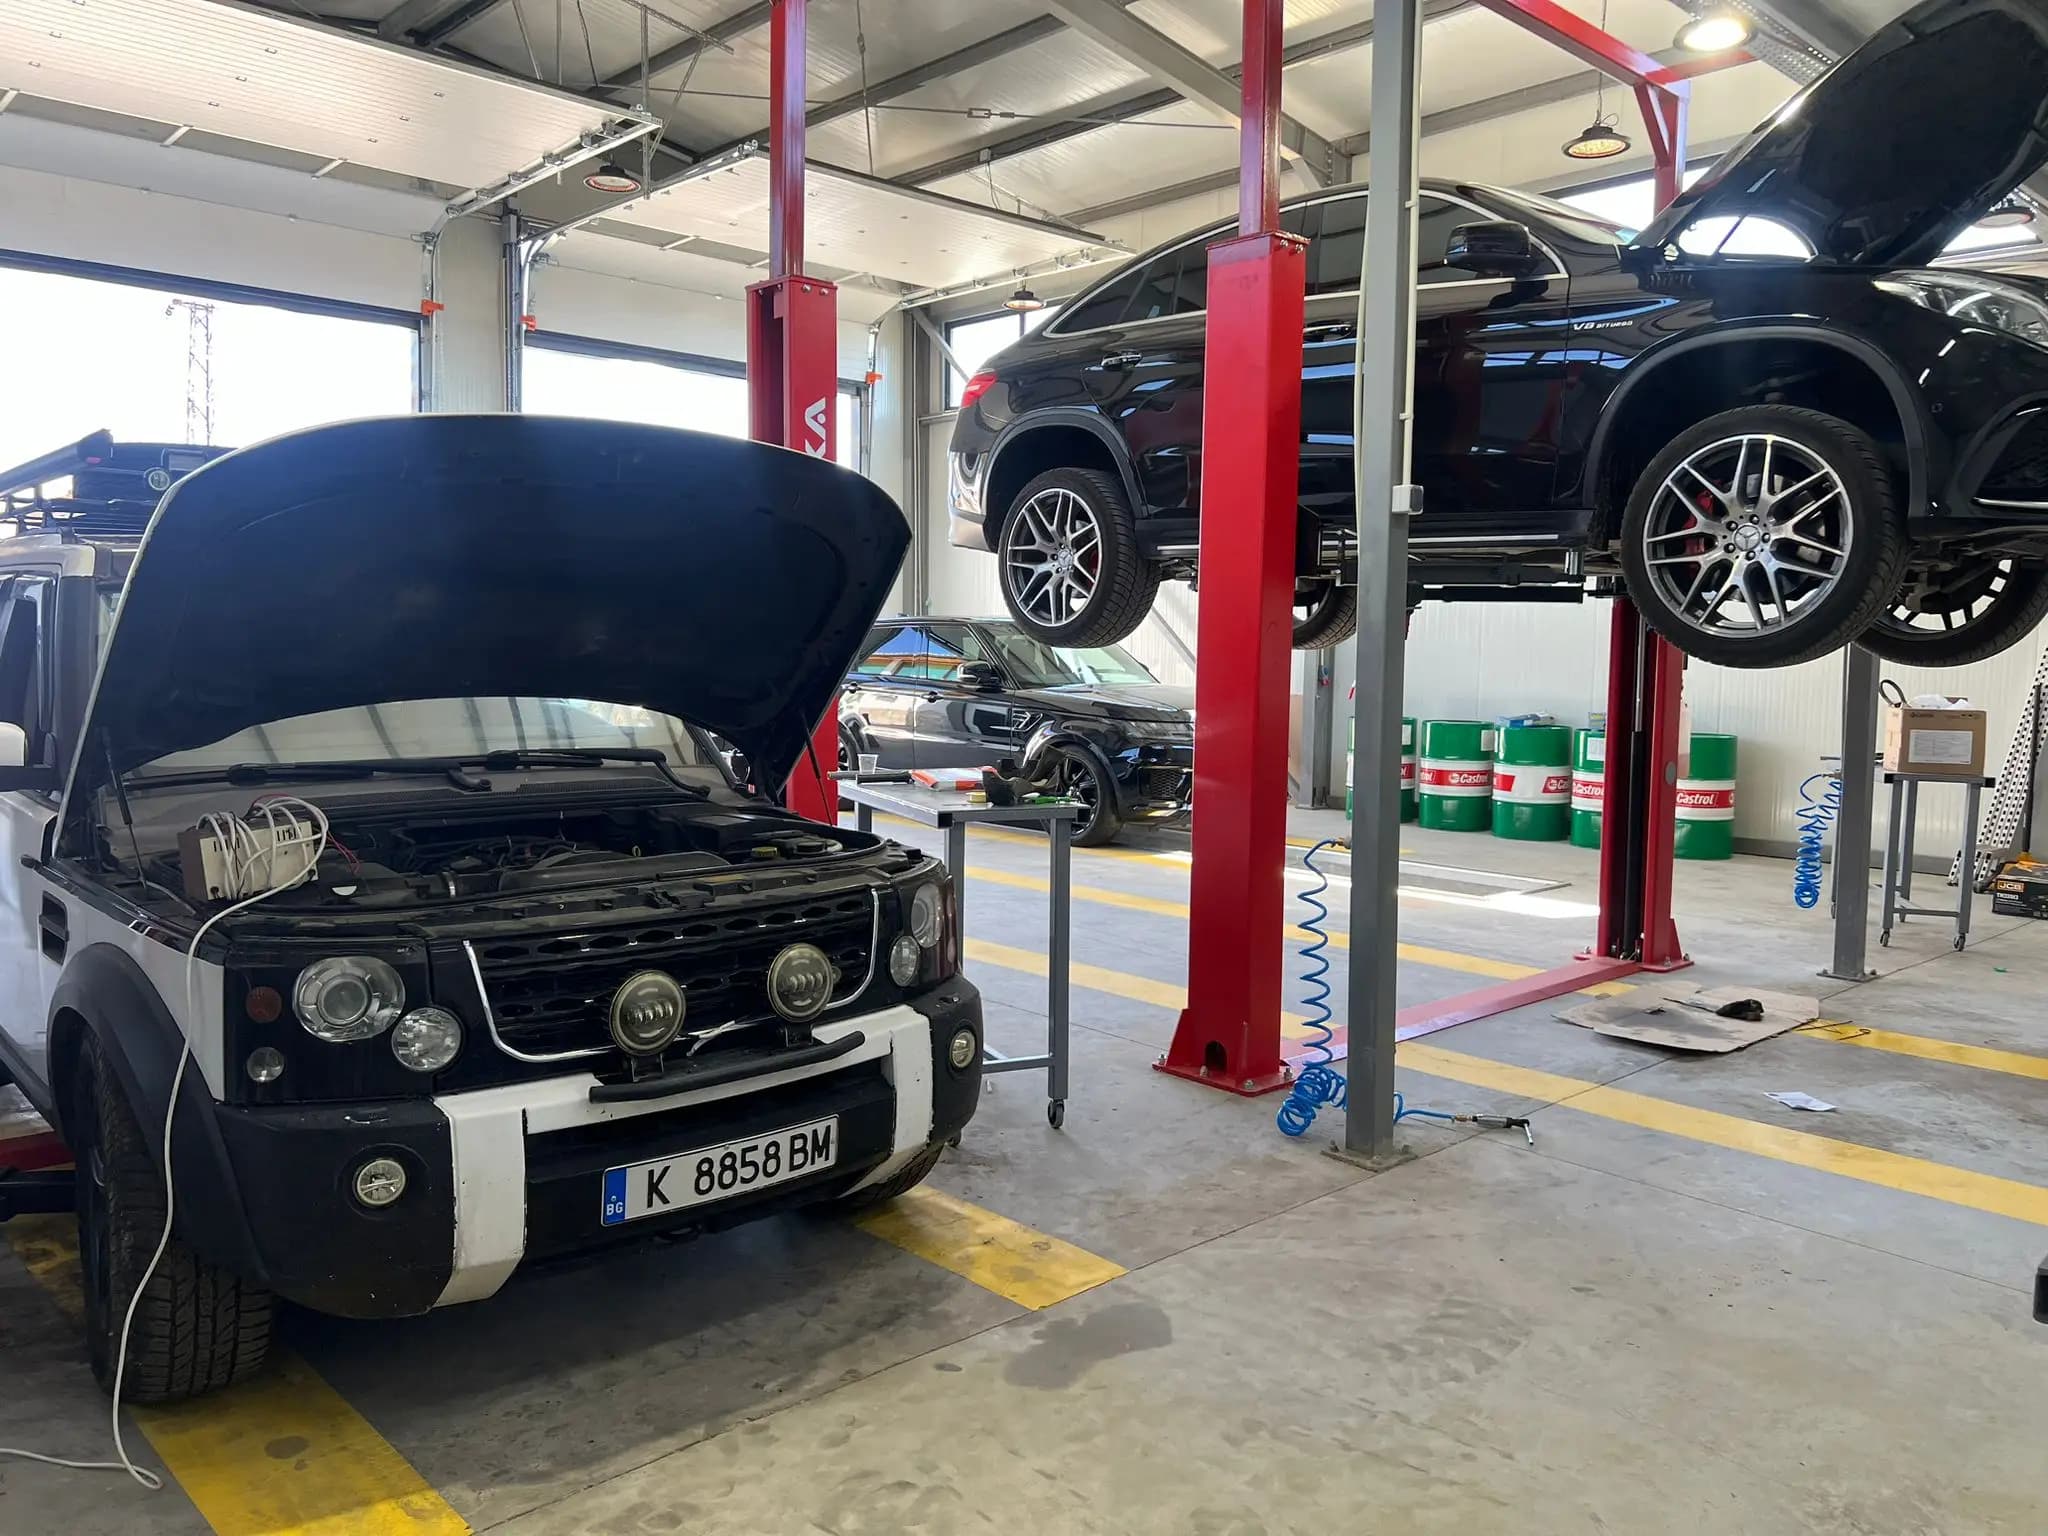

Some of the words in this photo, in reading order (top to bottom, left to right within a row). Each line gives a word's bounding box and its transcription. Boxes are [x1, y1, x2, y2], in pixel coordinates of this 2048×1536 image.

[1573, 322, 1595, 331] V8
[1676, 792, 1714, 805] Castrol
[647, 1165, 671, 1209] K
[694, 1140, 781, 1196] 8858
[789, 1125, 831, 1172] BM
[606, 1202, 624, 1216] BG
